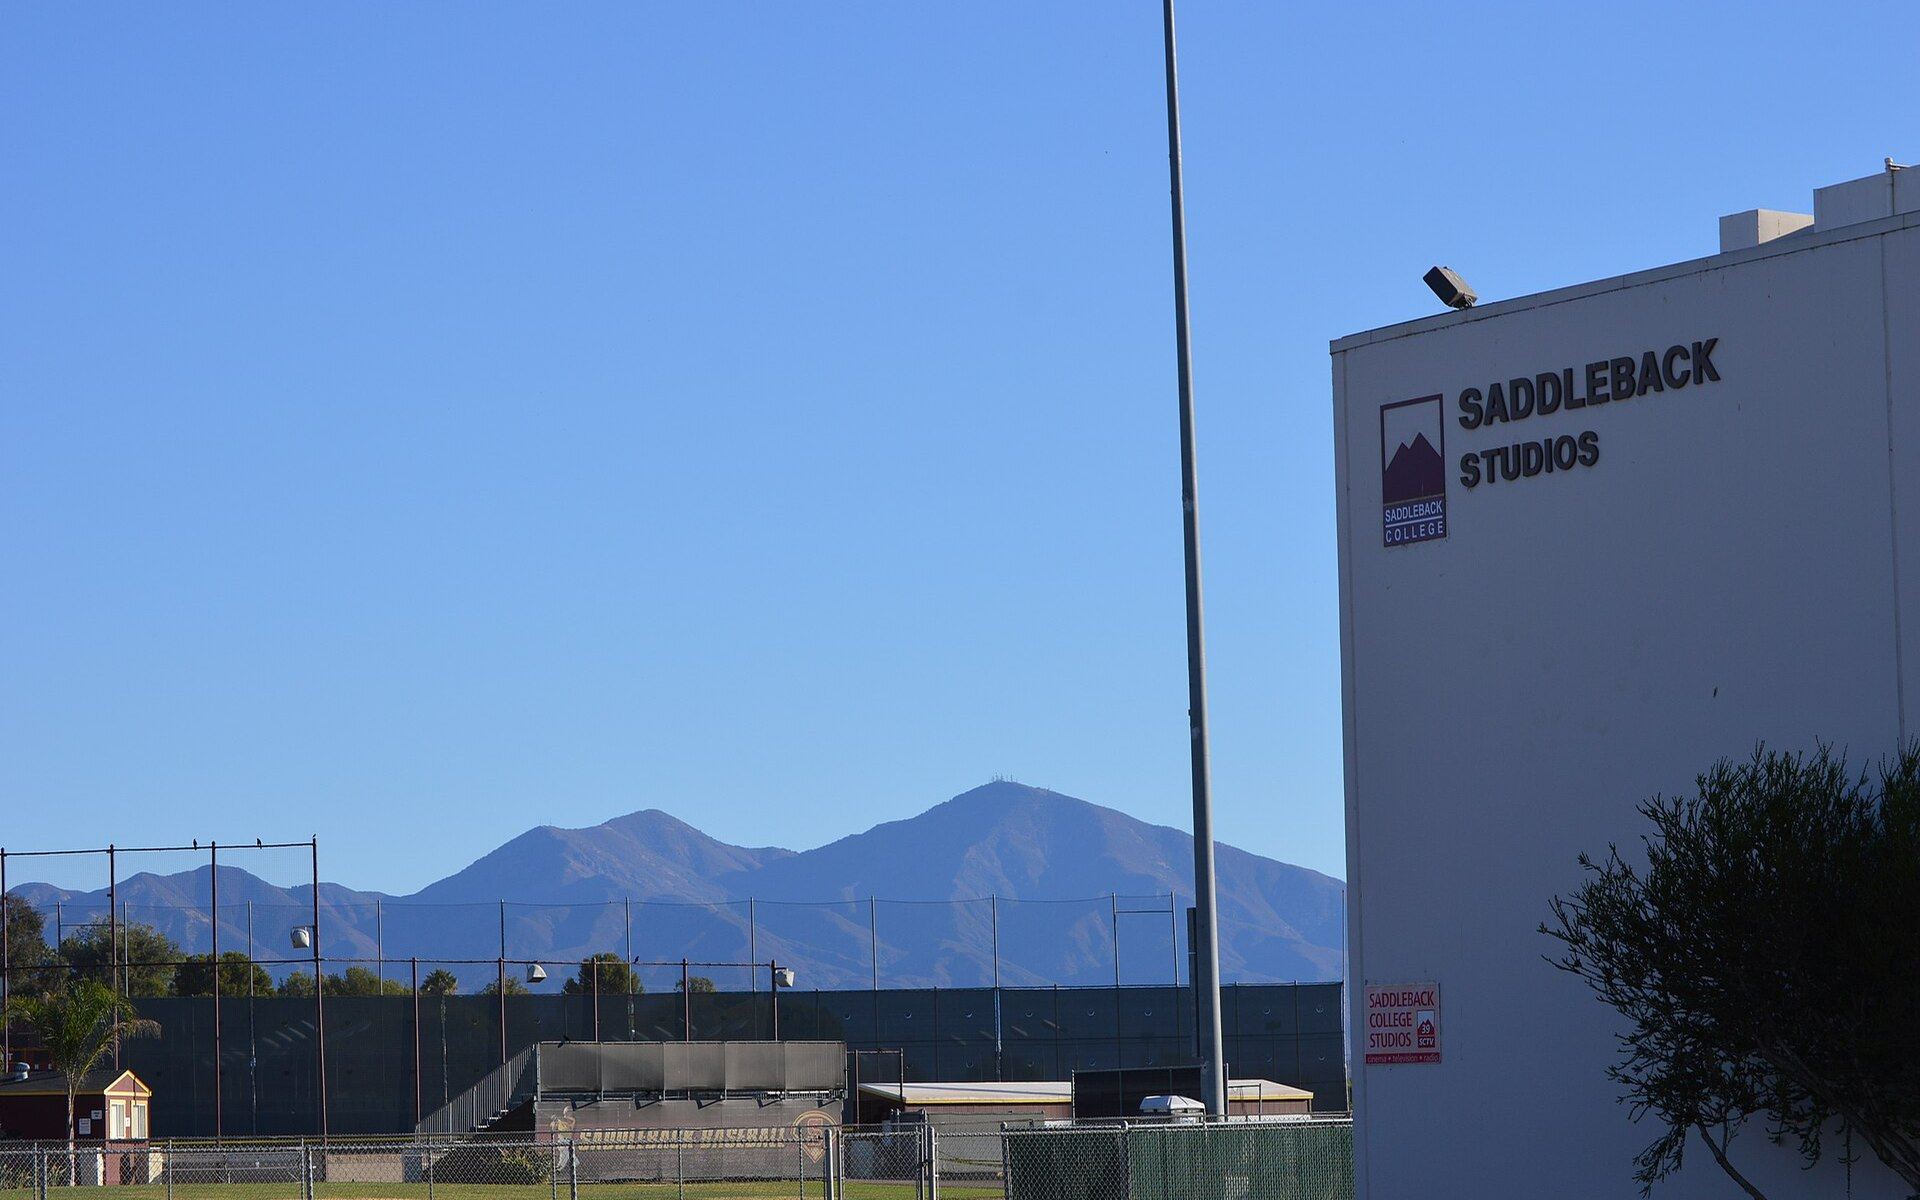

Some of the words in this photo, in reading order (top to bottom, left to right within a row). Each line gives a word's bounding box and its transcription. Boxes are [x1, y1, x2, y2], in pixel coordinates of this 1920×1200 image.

[1458, 337, 1721, 430] SADDLEBACK
[1460, 430, 1600, 488] STUDIOS
[1385, 500, 1443, 522] SADDLEBACK
[1385, 521, 1443, 543] COLLEGE
[1369, 991, 1435, 1008] SADDLEBACK
[1369, 1012, 1412, 1028] COLLEGE
[1421, 1025, 1431, 1034] 39
[1369, 1032, 1412, 1048] STUDIOS
[1419, 1037, 1434, 1046] SCTV
